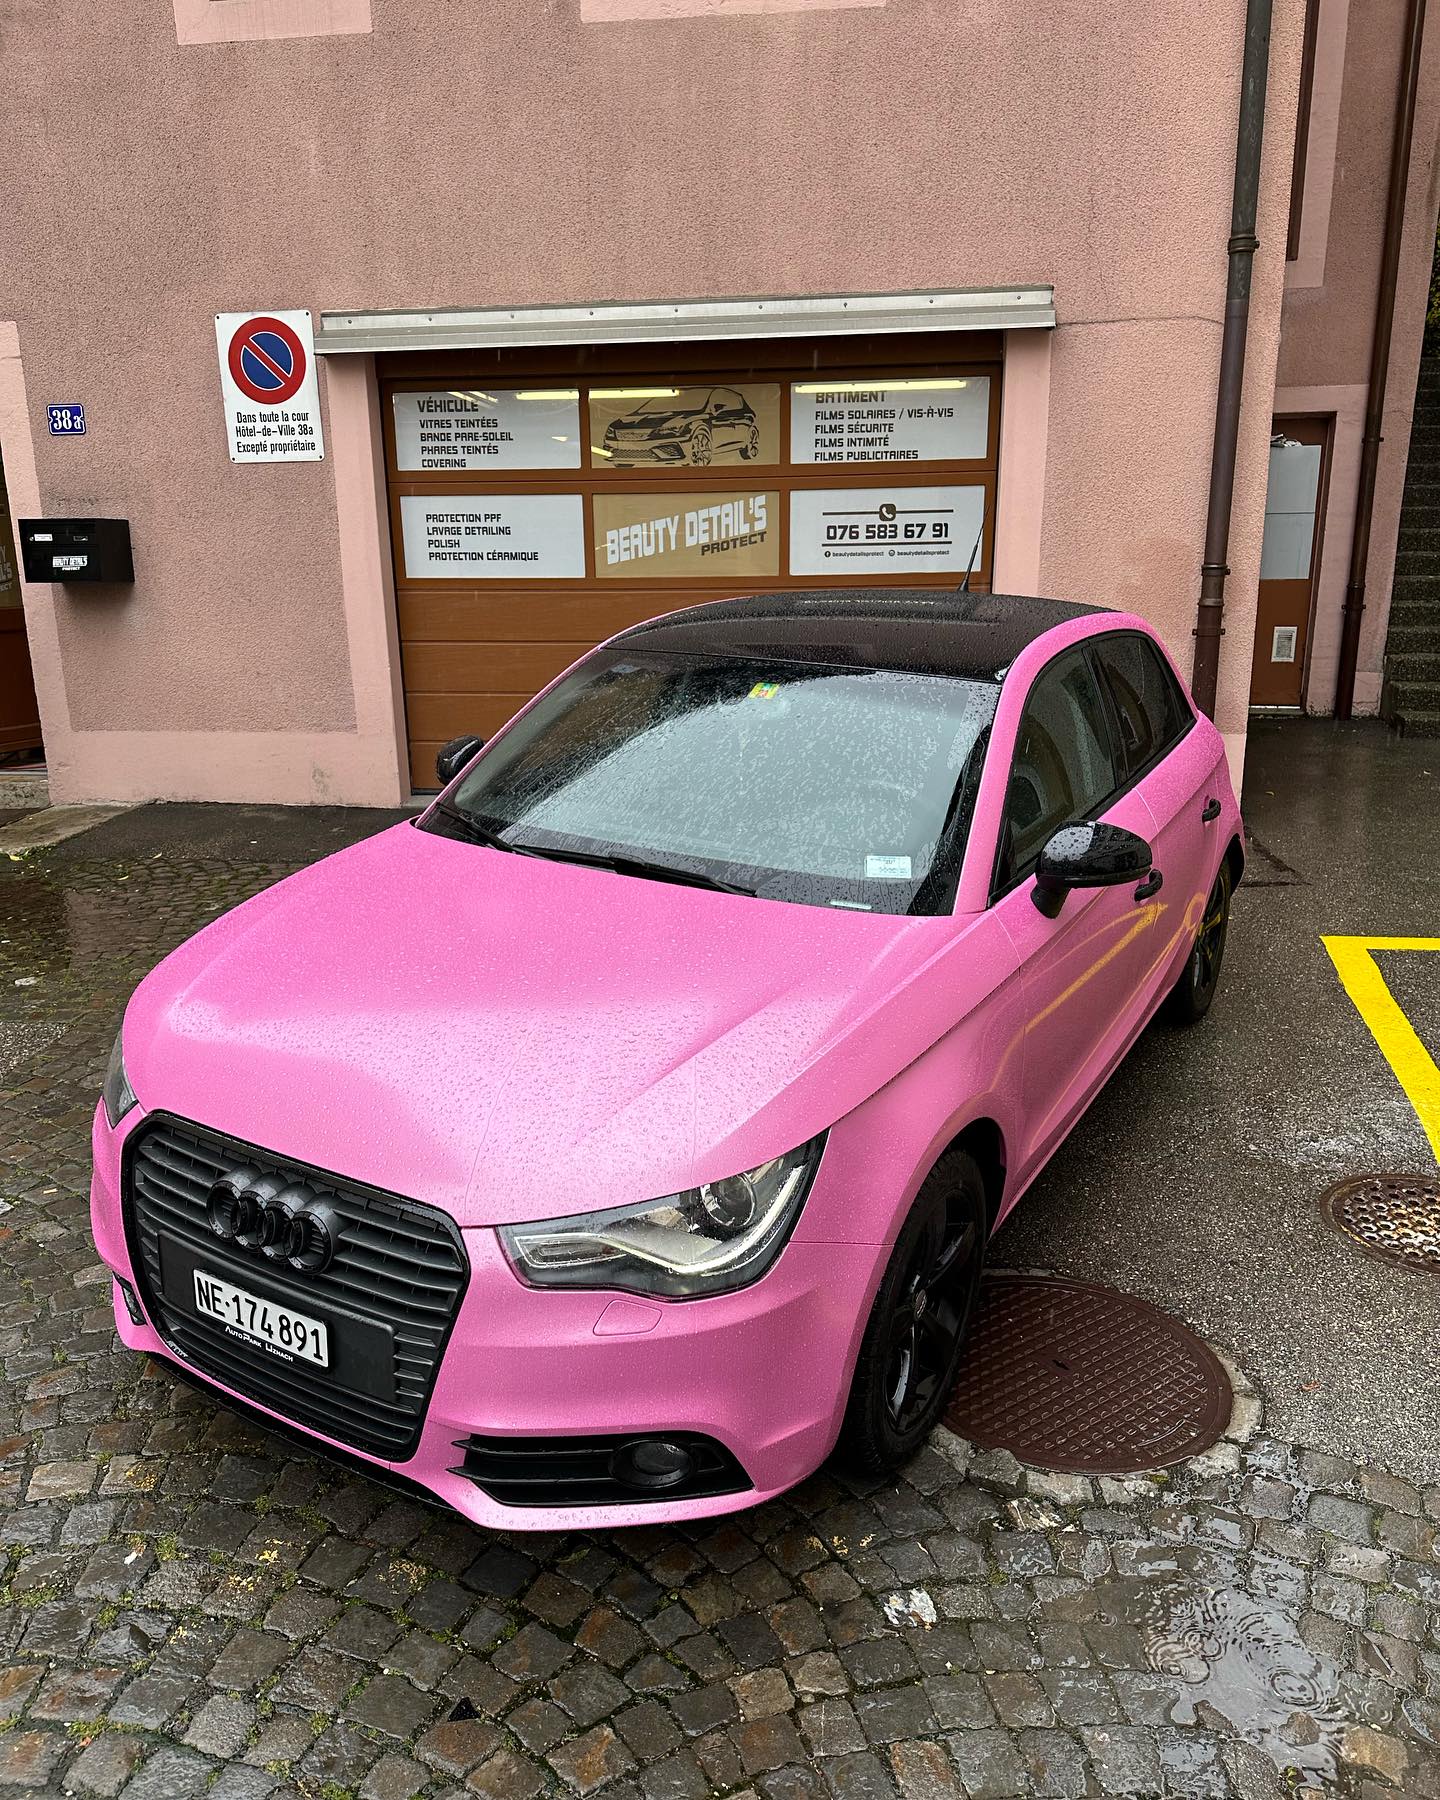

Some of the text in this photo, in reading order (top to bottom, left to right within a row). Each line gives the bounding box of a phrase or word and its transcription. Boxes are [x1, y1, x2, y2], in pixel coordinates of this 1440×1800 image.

[417, 396, 479, 413] VÉHICULE
[236, 410, 310, 423] Dans toute la cour
[815, 410, 845, 421] FILMS
[848, 409, 896, 420] SOLAIRES
[907, 406, 954, 418] VIS-À-VIS
[419, 416, 498, 428] VITRES TEINTÉES
[235, 423, 314, 438] Hôtel-de-Ville 38a
[815, 424, 844, 434] FILMS
[420, 432, 514, 442] BANDE PARE-SOLEIL
[814, 434, 889, 448] FILMS INTIMITÉ
[236, 440, 316, 455] Excepté propriétaire
[421, 442, 499, 455] PHARES TEINTÉS
[814, 450, 919, 462] FILMS PUBLICITAIRES
[422, 458, 467, 468] COVERING
[425, 513, 502, 523] PROTECTION PPF
[427, 526, 511, 536] LAVAGE DETAILING
[606, 494, 768, 565] BEAUTY DETAIL'S
[826, 522, 949, 540] 076 583 67 91
[428, 539, 460, 548] POLISH
[701, 531, 768, 556] PROTECT
[429, 549, 539, 562] PROTECTION CÉRAMIQUE
